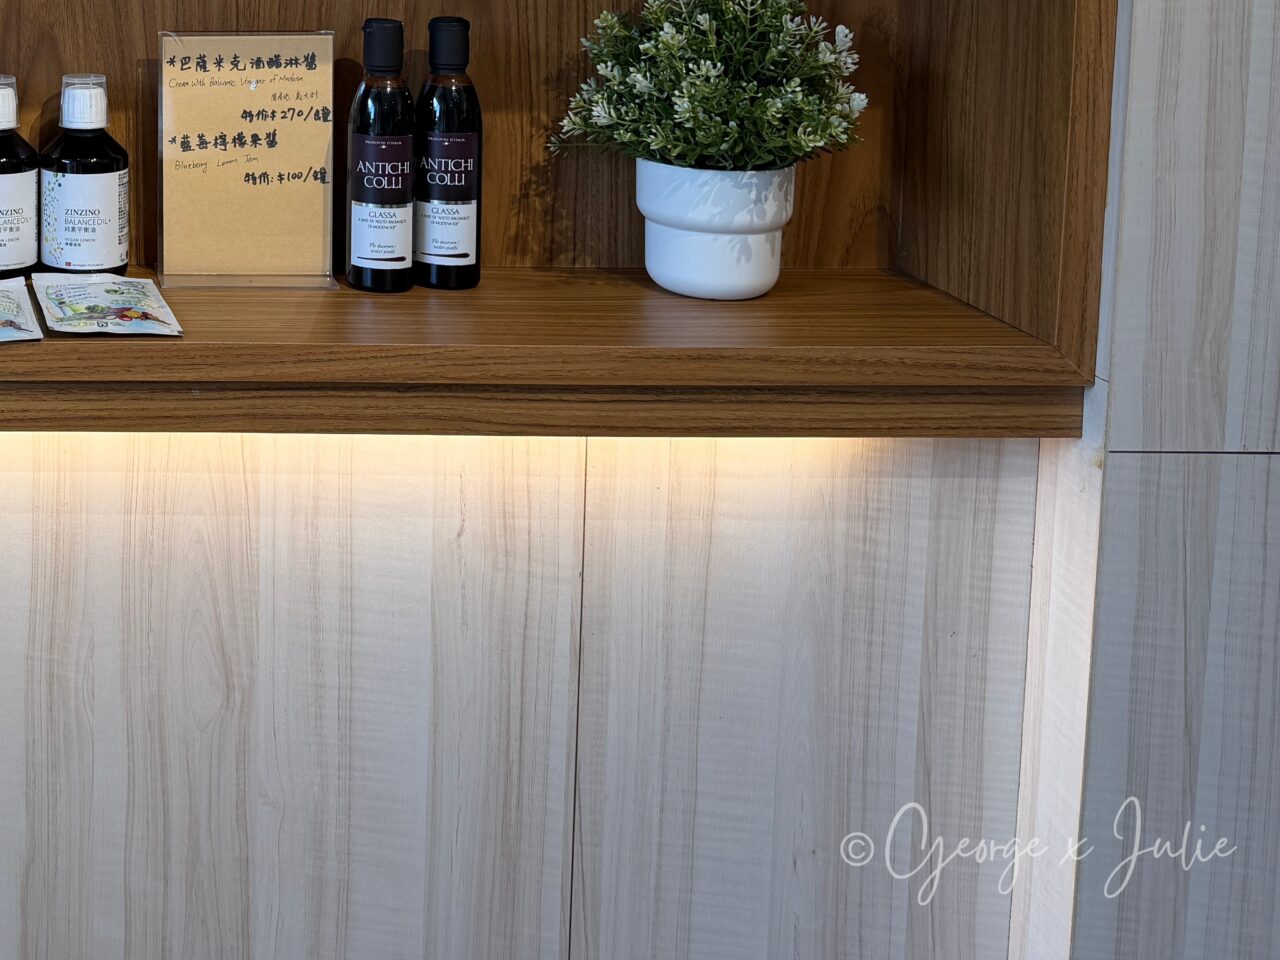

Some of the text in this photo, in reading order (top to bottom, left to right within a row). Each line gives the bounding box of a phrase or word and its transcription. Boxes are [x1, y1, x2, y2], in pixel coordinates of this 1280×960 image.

[356, 160, 410, 175] ANTICHI
[420, 156, 474, 171] ANTICHI
[363, 175, 402, 189] COLLI
[426, 171, 465, 185] COLLI
[64, 208, 100, 216] ZINZINO
[368, 211, 397, 219] GLASSA
[431, 207, 460, 215] GLASSA
